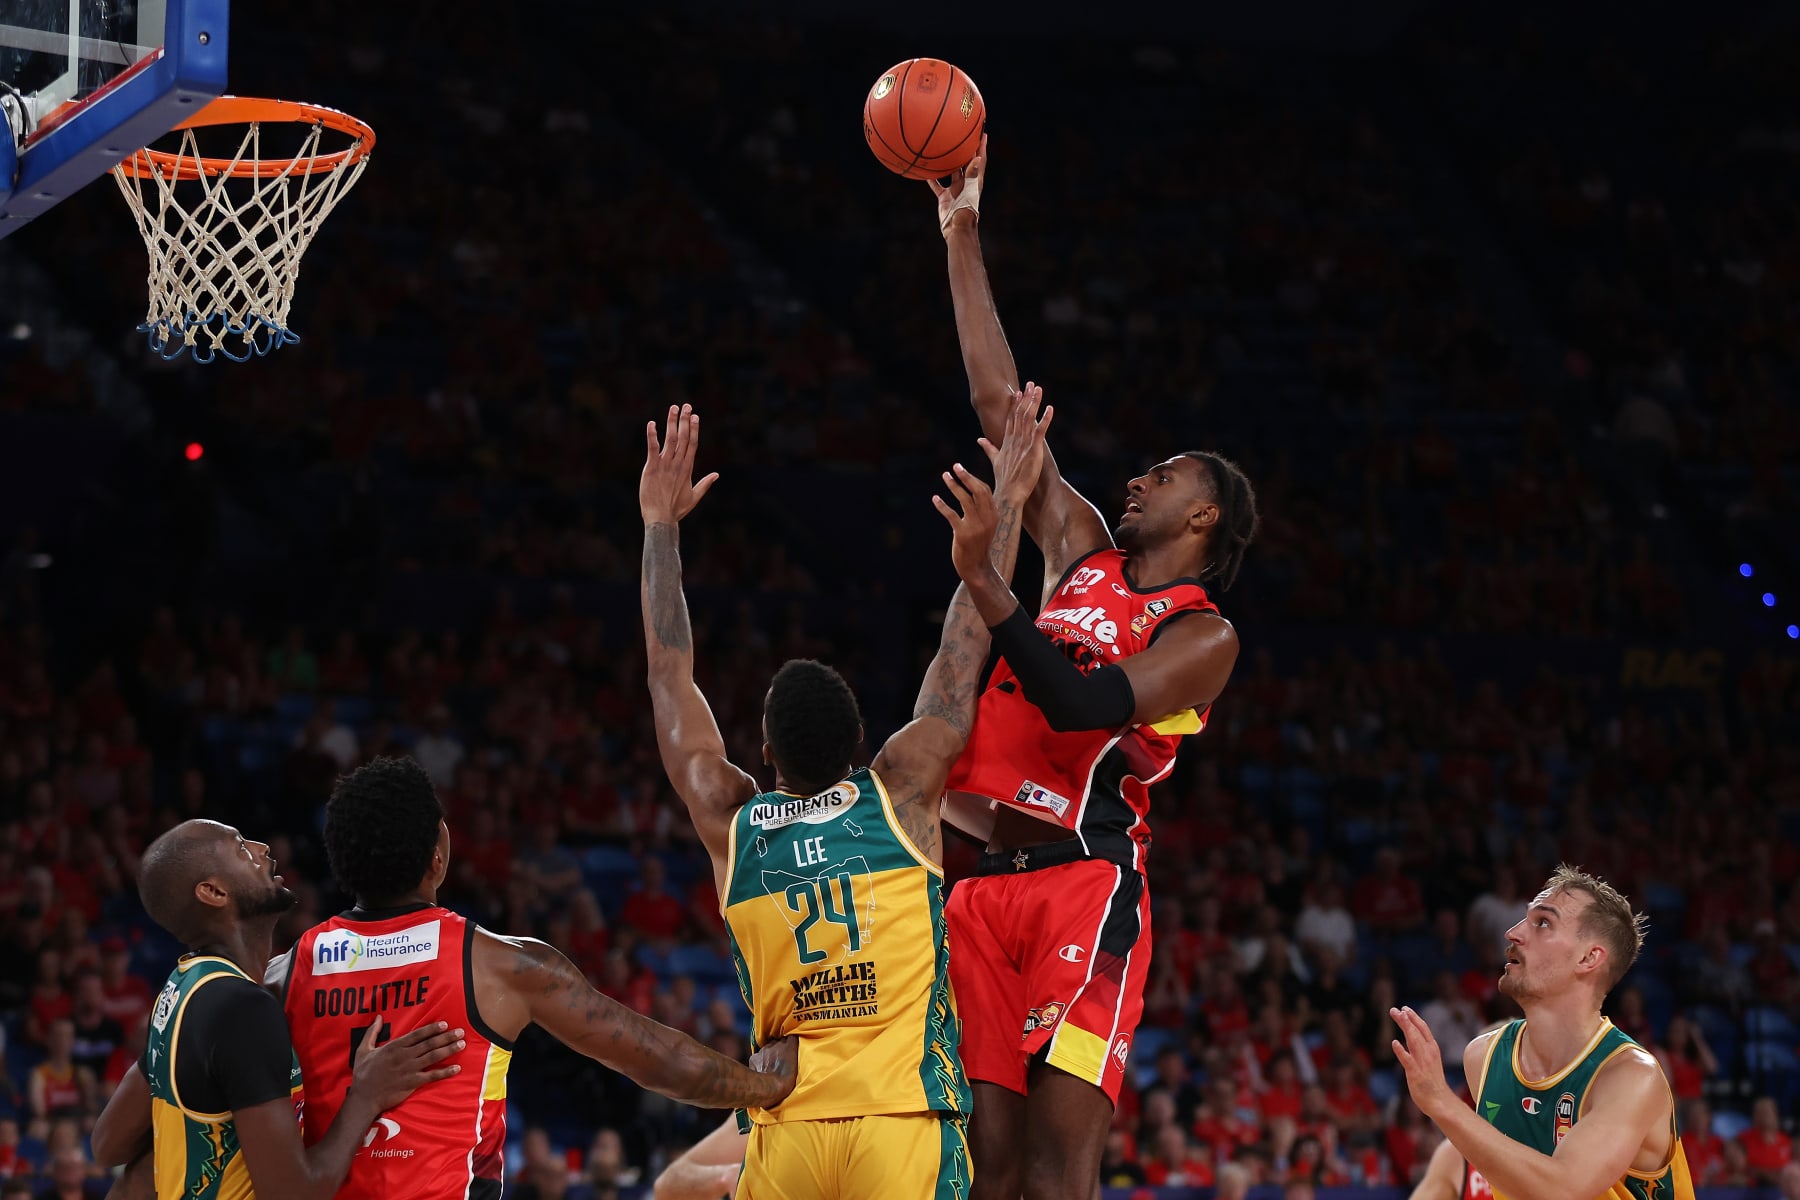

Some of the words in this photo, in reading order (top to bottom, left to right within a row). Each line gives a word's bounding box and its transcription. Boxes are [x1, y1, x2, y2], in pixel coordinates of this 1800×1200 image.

[1068, 629, 1104, 656] mobile
[1621, 647, 1724, 689] RAC
[753, 791, 843, 821] NUTRIENTS
[765, 817, 783, 826] PURE
[793, 836, 828, 868] LEE
[785, 871, 861, 966] 24
[318, 940, 350, 964] hif
[366, 942, 432, 959] Insurance
[790, 961, 876, 993] WILLIE
[313, 976, 430, 1018] DOOLITTLE
[793, 1005, 878, 1022] TASMANIAN
[370, 1149, 414, 1159] Holdings
